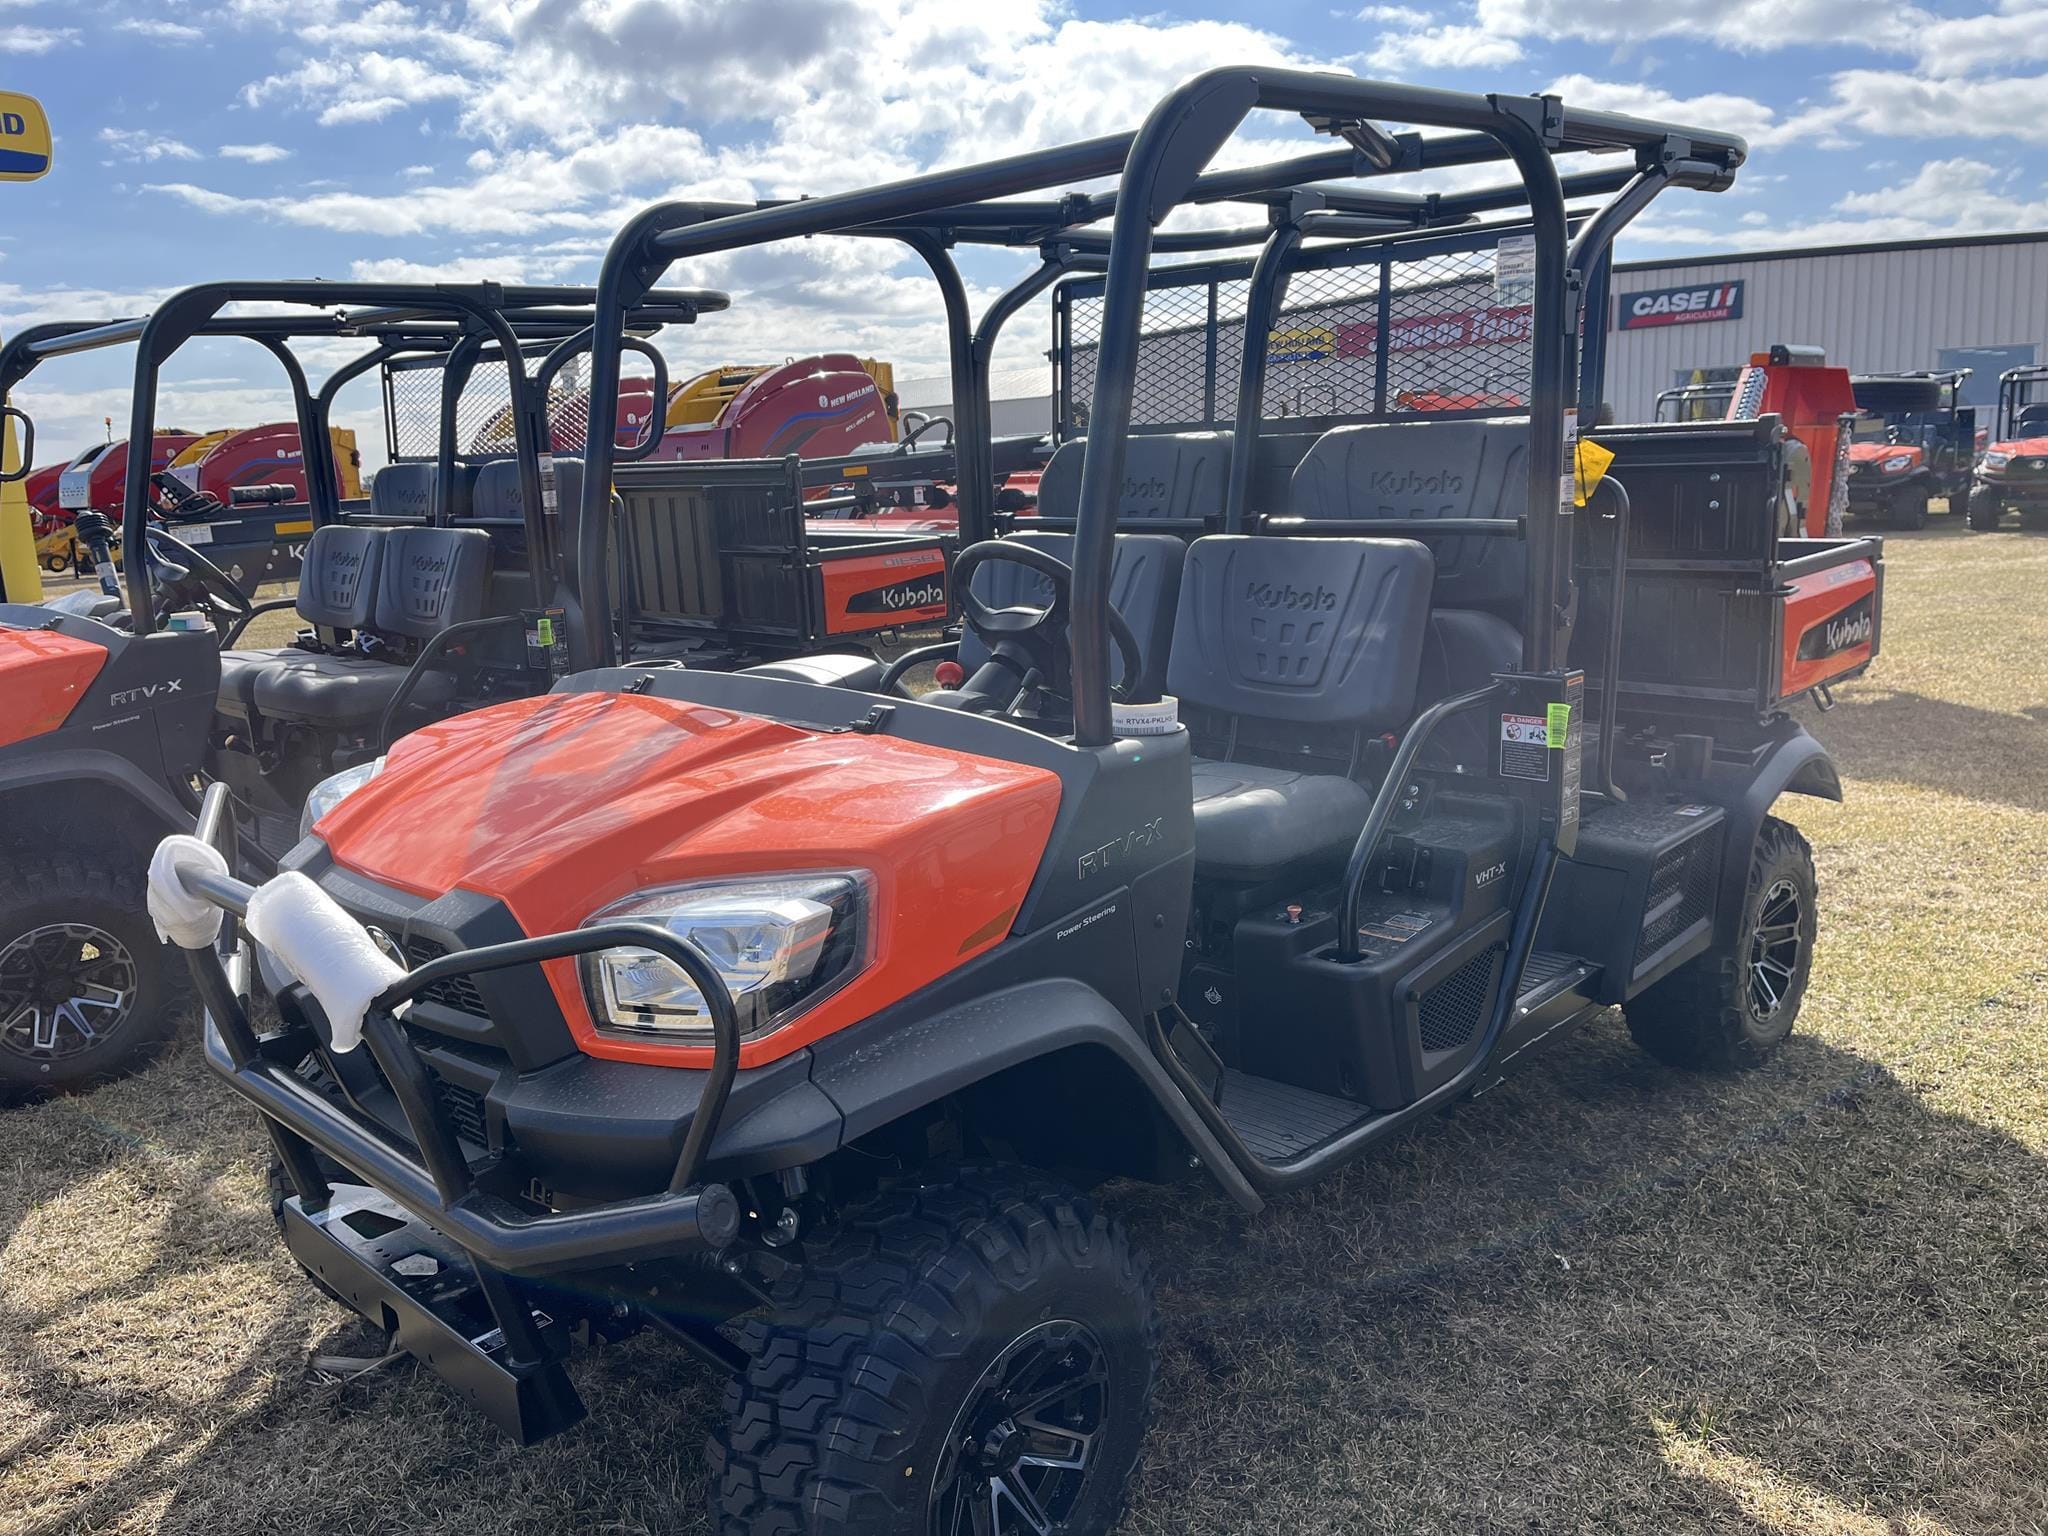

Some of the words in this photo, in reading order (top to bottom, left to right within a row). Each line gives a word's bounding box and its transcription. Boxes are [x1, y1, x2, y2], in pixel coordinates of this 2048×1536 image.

[1632, 290, 1710, 316] CASE
[1674, 308, 1728, 321] AGRICULTURE
[830, 395, 846, 408] NEW
[846, 384, 875, 402] HOLLAND
[1369, 470, 1463, 496] Kubota
[882, 584, 944, 609] Kubota
[1246, 581, 1337, 612] Kubota
[1826, 611, 1871, 650] Kubota
[110, 678, 182, 706] RTV-X
[1517, 716, 1543, 725] DANGER
[1078, 817, 1163, 880] RTV-X
[1475, 861, 1506, 884] VHT-X
[1057, 921, 1083, 940] Power
[1082, 904, 1117, 928] Steering
